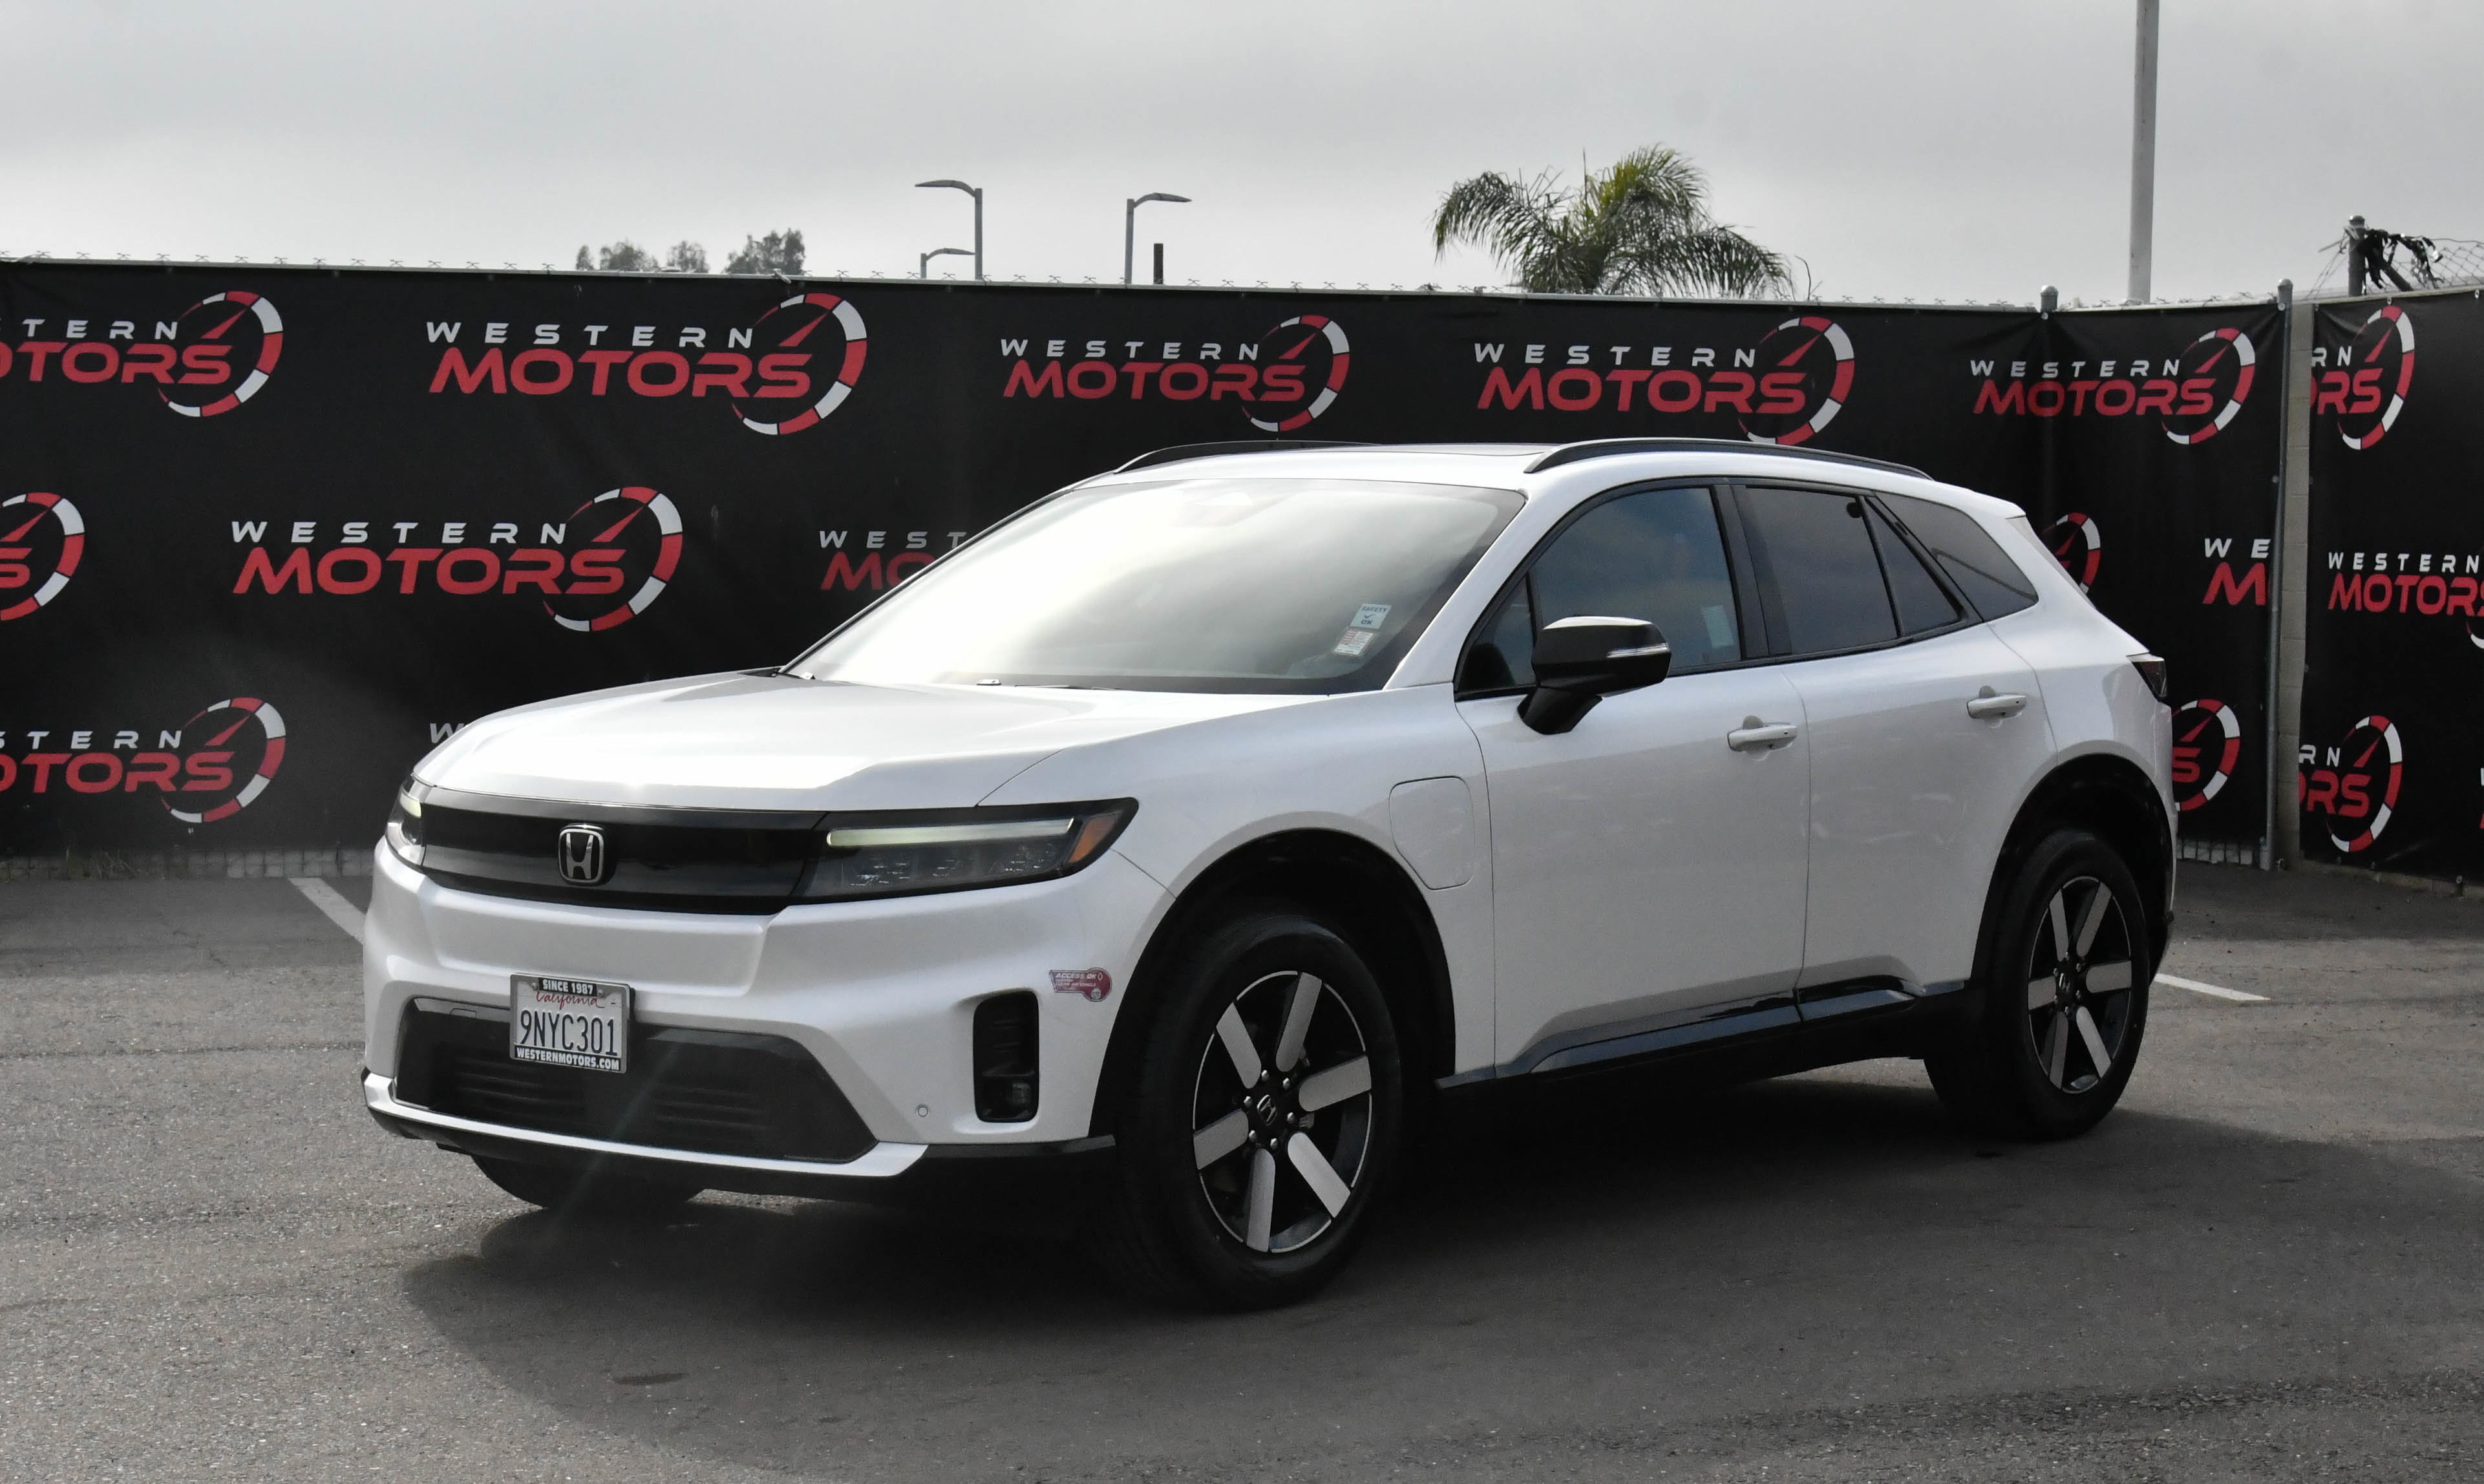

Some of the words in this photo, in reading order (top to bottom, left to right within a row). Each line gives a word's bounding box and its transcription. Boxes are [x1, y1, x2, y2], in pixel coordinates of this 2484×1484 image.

[0, 319, 178, 340] TERN
[426, 321, 753, 349] WESTERN
[1001, 339, 1258, 361] WESTERN
[1474, 343, 1756, 368] WESTERN
[0, 341, 233, 385] TORS
[429, 346, 812, 398] MOTORS
[1970, 359, 2180, 378] WESTERN
[1003, 359, 1306, 401] MOTORS
[1478, 366, 1806, 414] MOTORS
[1973, 378, 2216, 417] MOTORS
[231, 521, 566, 544] WESTERN
[233, 546, 627, 595] MOTORS
[2328, 552, 2480, 574] WESTERN
[2328, 573, 2484, 617] MOTOR
[0, 730, 182, 750] TERN
[542, 979, 569, 992] SINCE
[571, 982, 593, 995] 1987
[535, 991, 606, 1010] California
[520, 1010, 618, 1056] 9NYC301
[516, 1047, 620, 1071] WESTERNMOTORS.COM
